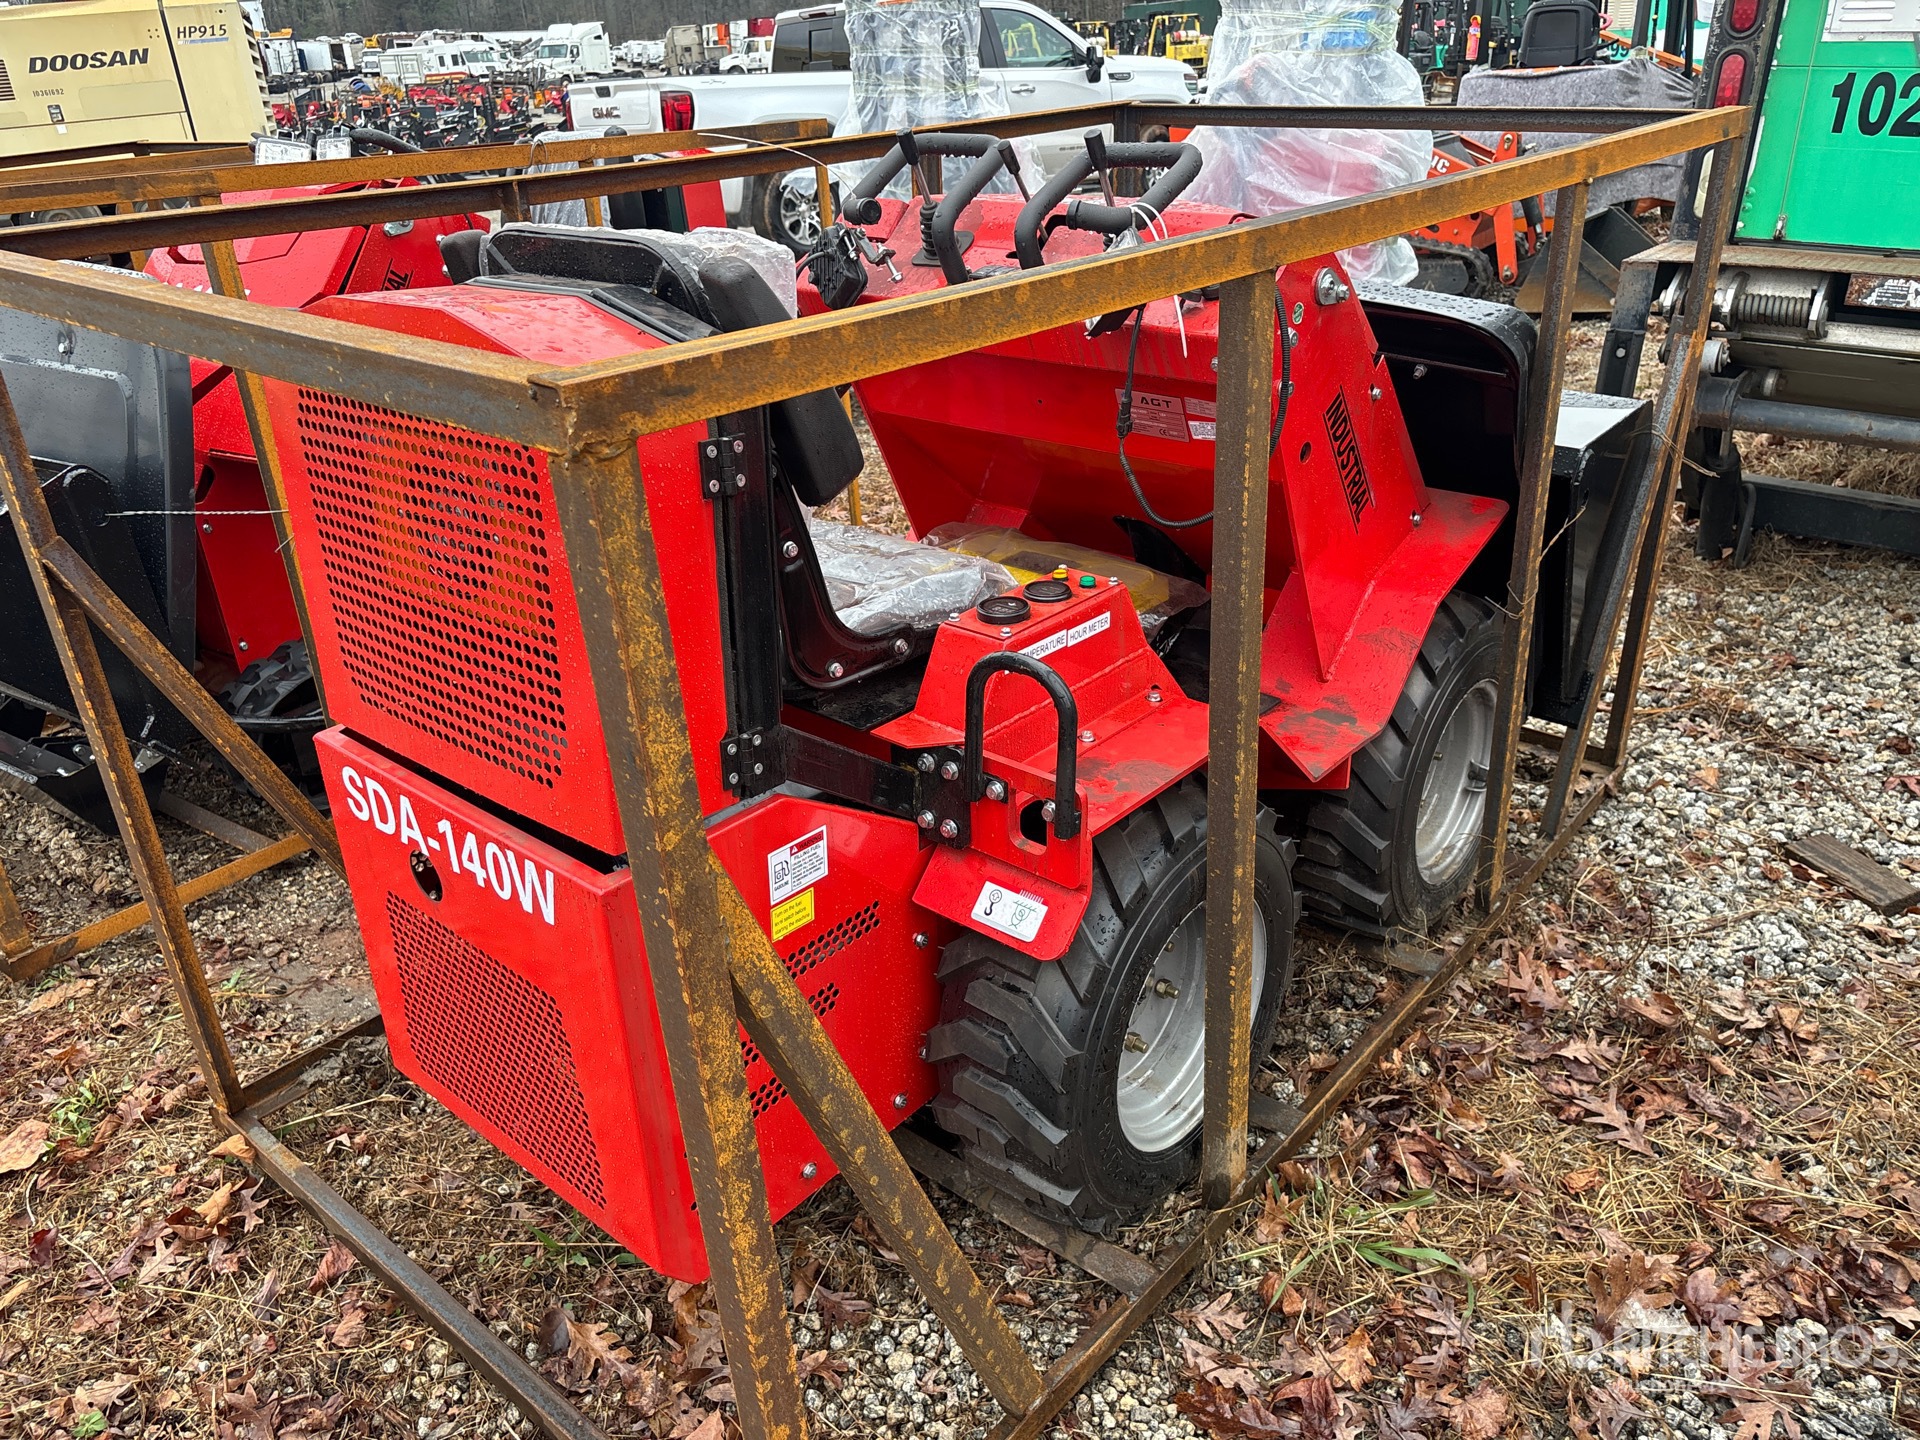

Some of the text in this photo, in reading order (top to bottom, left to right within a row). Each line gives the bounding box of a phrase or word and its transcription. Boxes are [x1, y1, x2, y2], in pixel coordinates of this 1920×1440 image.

[176, 24, 228, 39] HP915
[28, 48, 149, 74] DOOSAN
[32, 88, 65, 98] 10361692
[592, 106, 622, 119] GMC
[1831, 71, 1920, 138] 102
[1140, 396, 1172, 408] AGT
[1326, 392, 1369, 524] INDUSTRIAL
[1070, 616, 1108, 642] HOUR METER
[341, 765, 555, 926] SDA-140W
[799, 834, 822, 848] WARNING
